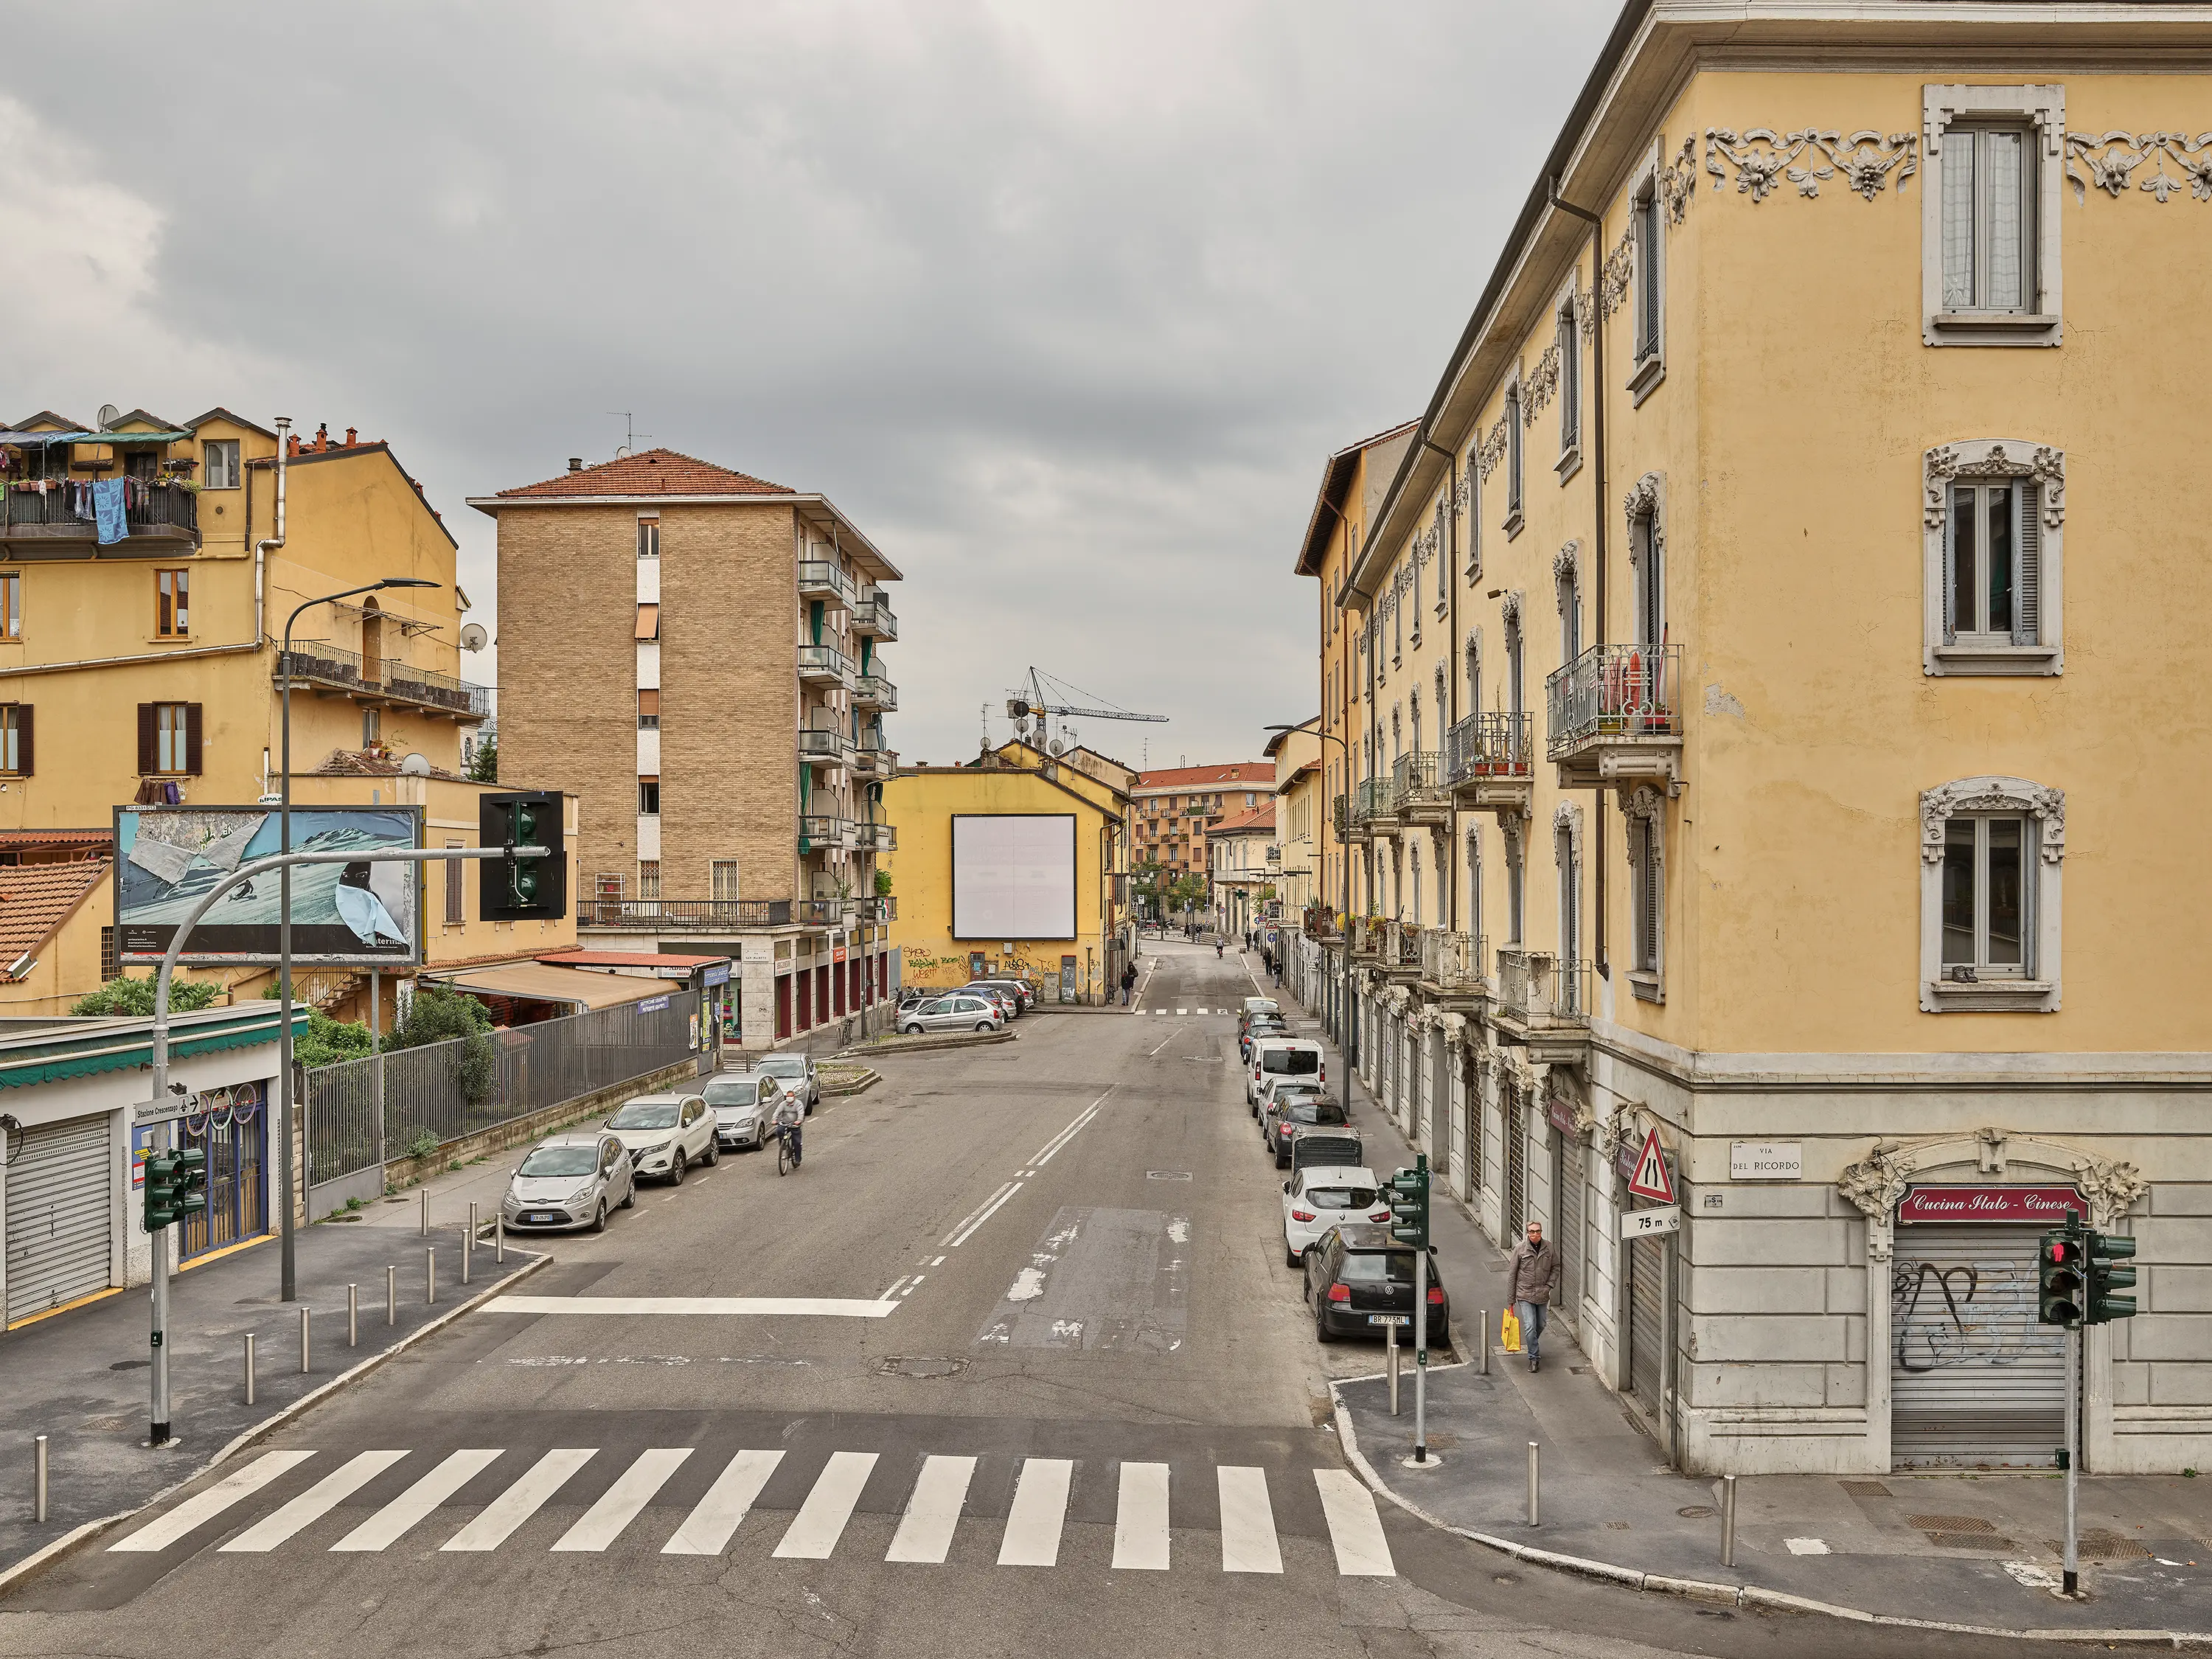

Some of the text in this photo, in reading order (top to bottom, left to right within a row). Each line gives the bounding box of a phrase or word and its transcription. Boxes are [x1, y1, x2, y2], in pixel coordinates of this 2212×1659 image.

[137, 1105, 178, 1118] Stazione Crescenzago
[1754, 1161, 1800, 1170] RICORDO
[1913, 1194, 1968, 1211] Cucina
[1968, 1194, 2011, 1211] Italo
[2023, 1194, 2074, 1211] Cinese
[1638, 1217, 1652, 1229] 75
[1373, 1315, 1382, 1324] BR
